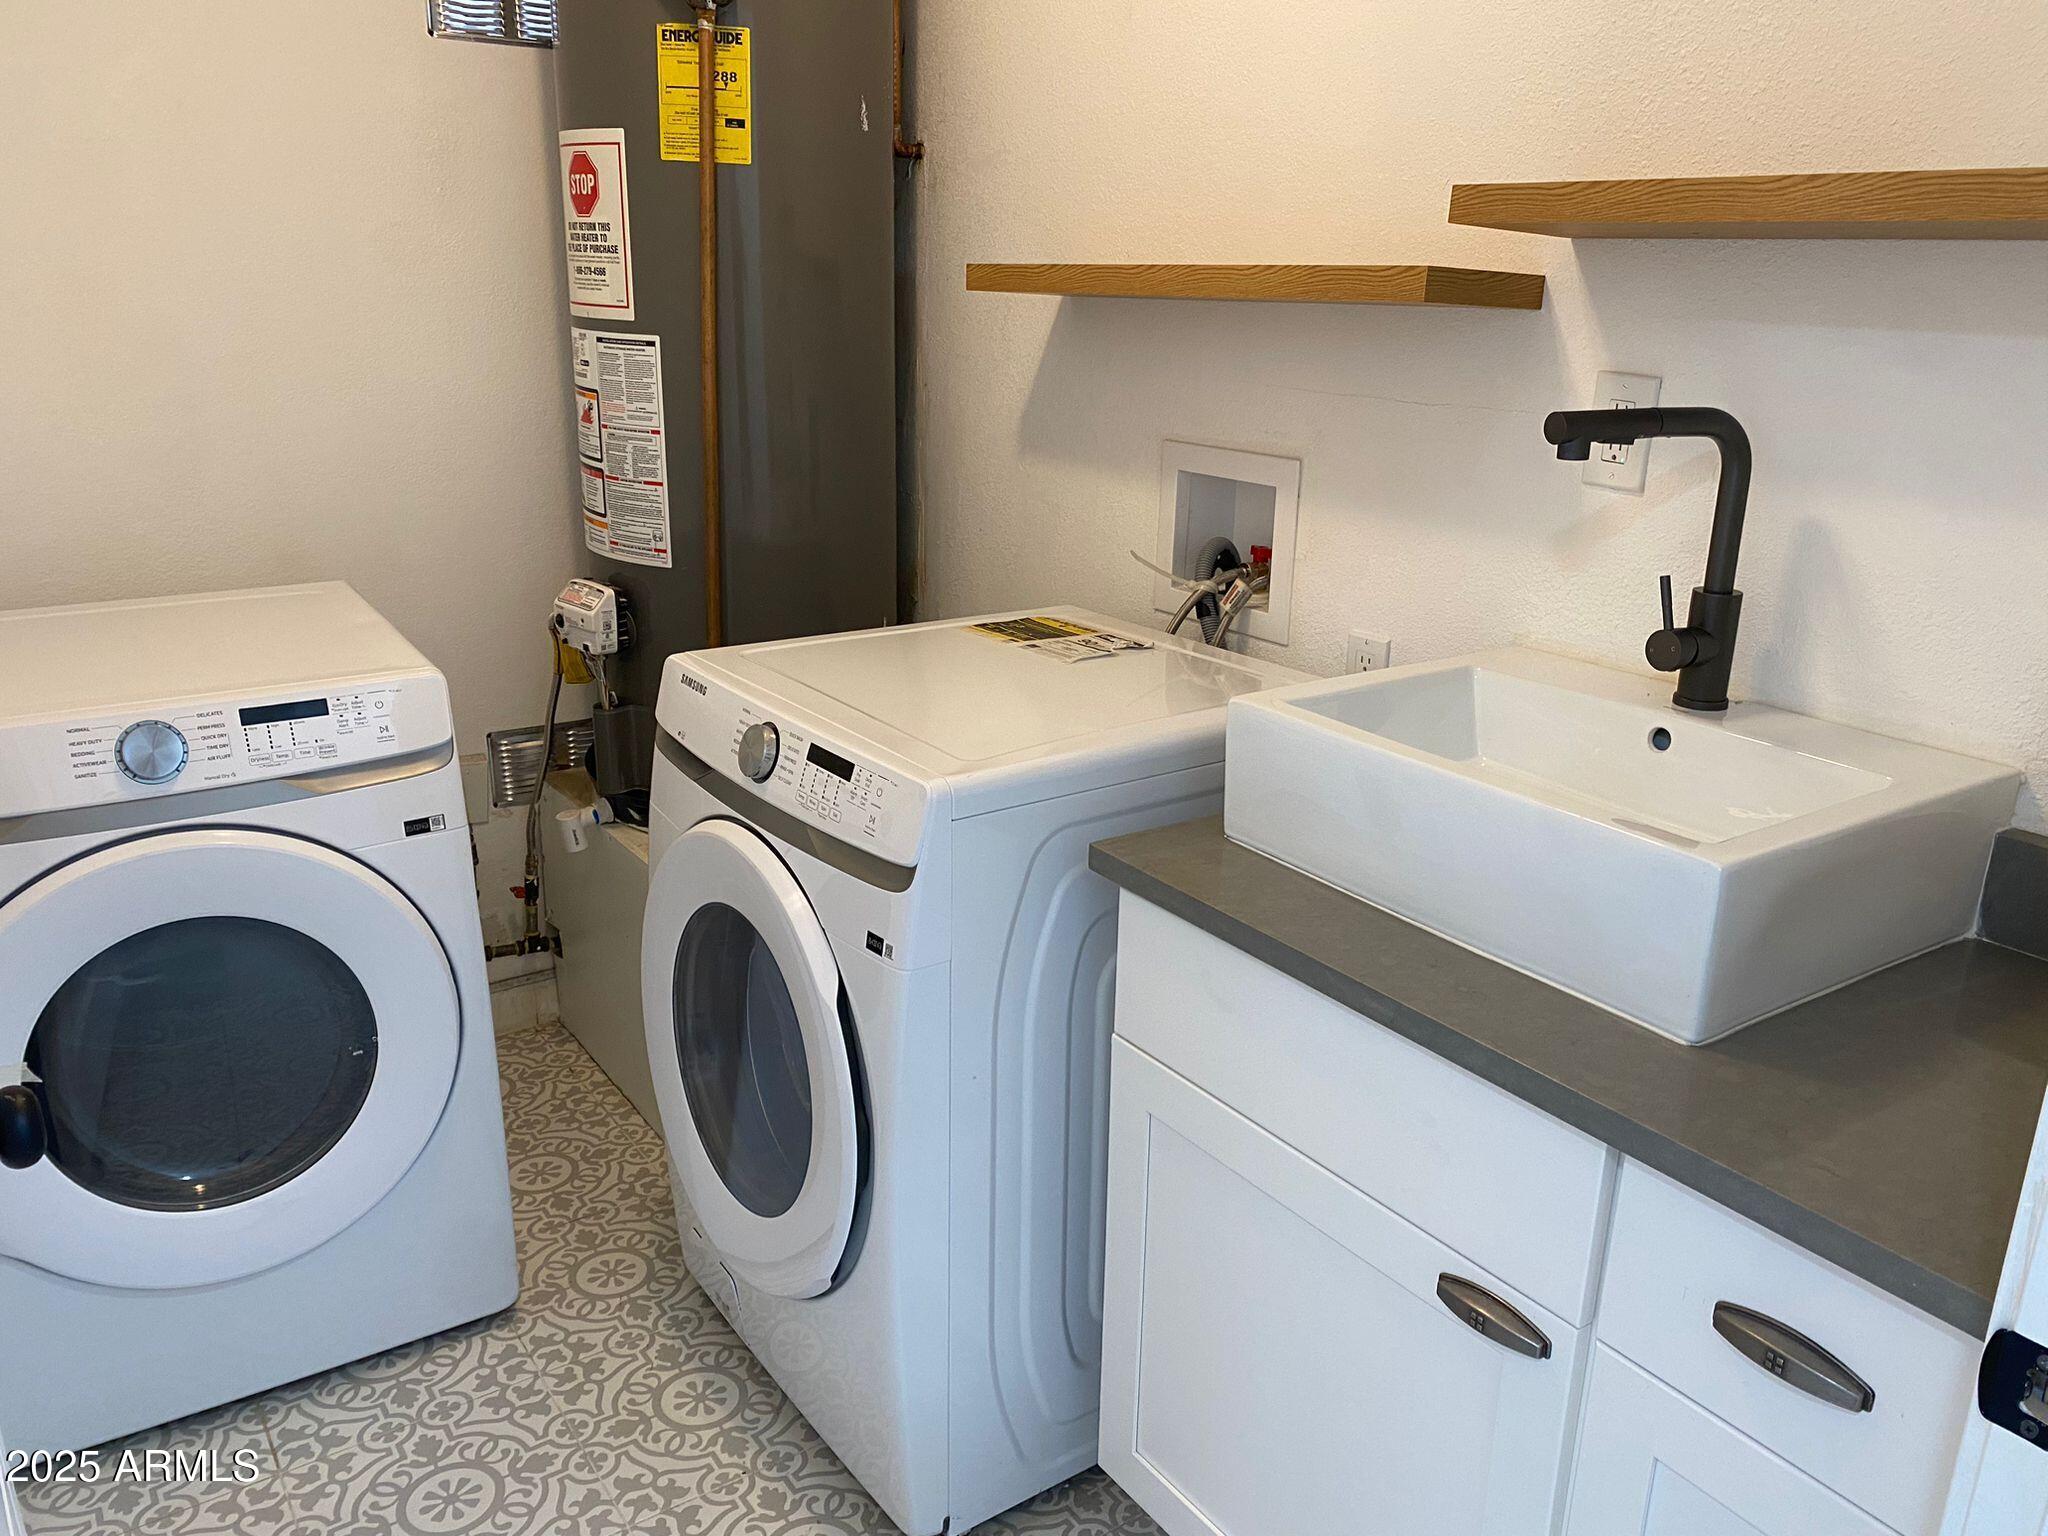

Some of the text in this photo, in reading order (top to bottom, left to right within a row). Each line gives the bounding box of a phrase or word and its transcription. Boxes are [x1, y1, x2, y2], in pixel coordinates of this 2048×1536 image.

[662, 29, 743, 46] ENERGUIDE
[571, 173, 595, 196] STOP
[578, 222, 597, 231] RETURN
[597, 222, 611, 232] THIS
[581, 233, 599, 242] HEATER
[599, 233, 608, 243] TO
[583, 244, 588, 253] OF
[589, 244, 619, 254] PURCHASE
[680, 673, 708, 696] SAMSUNG
[72, 760, 107, 769] ACTIVEWEAR
